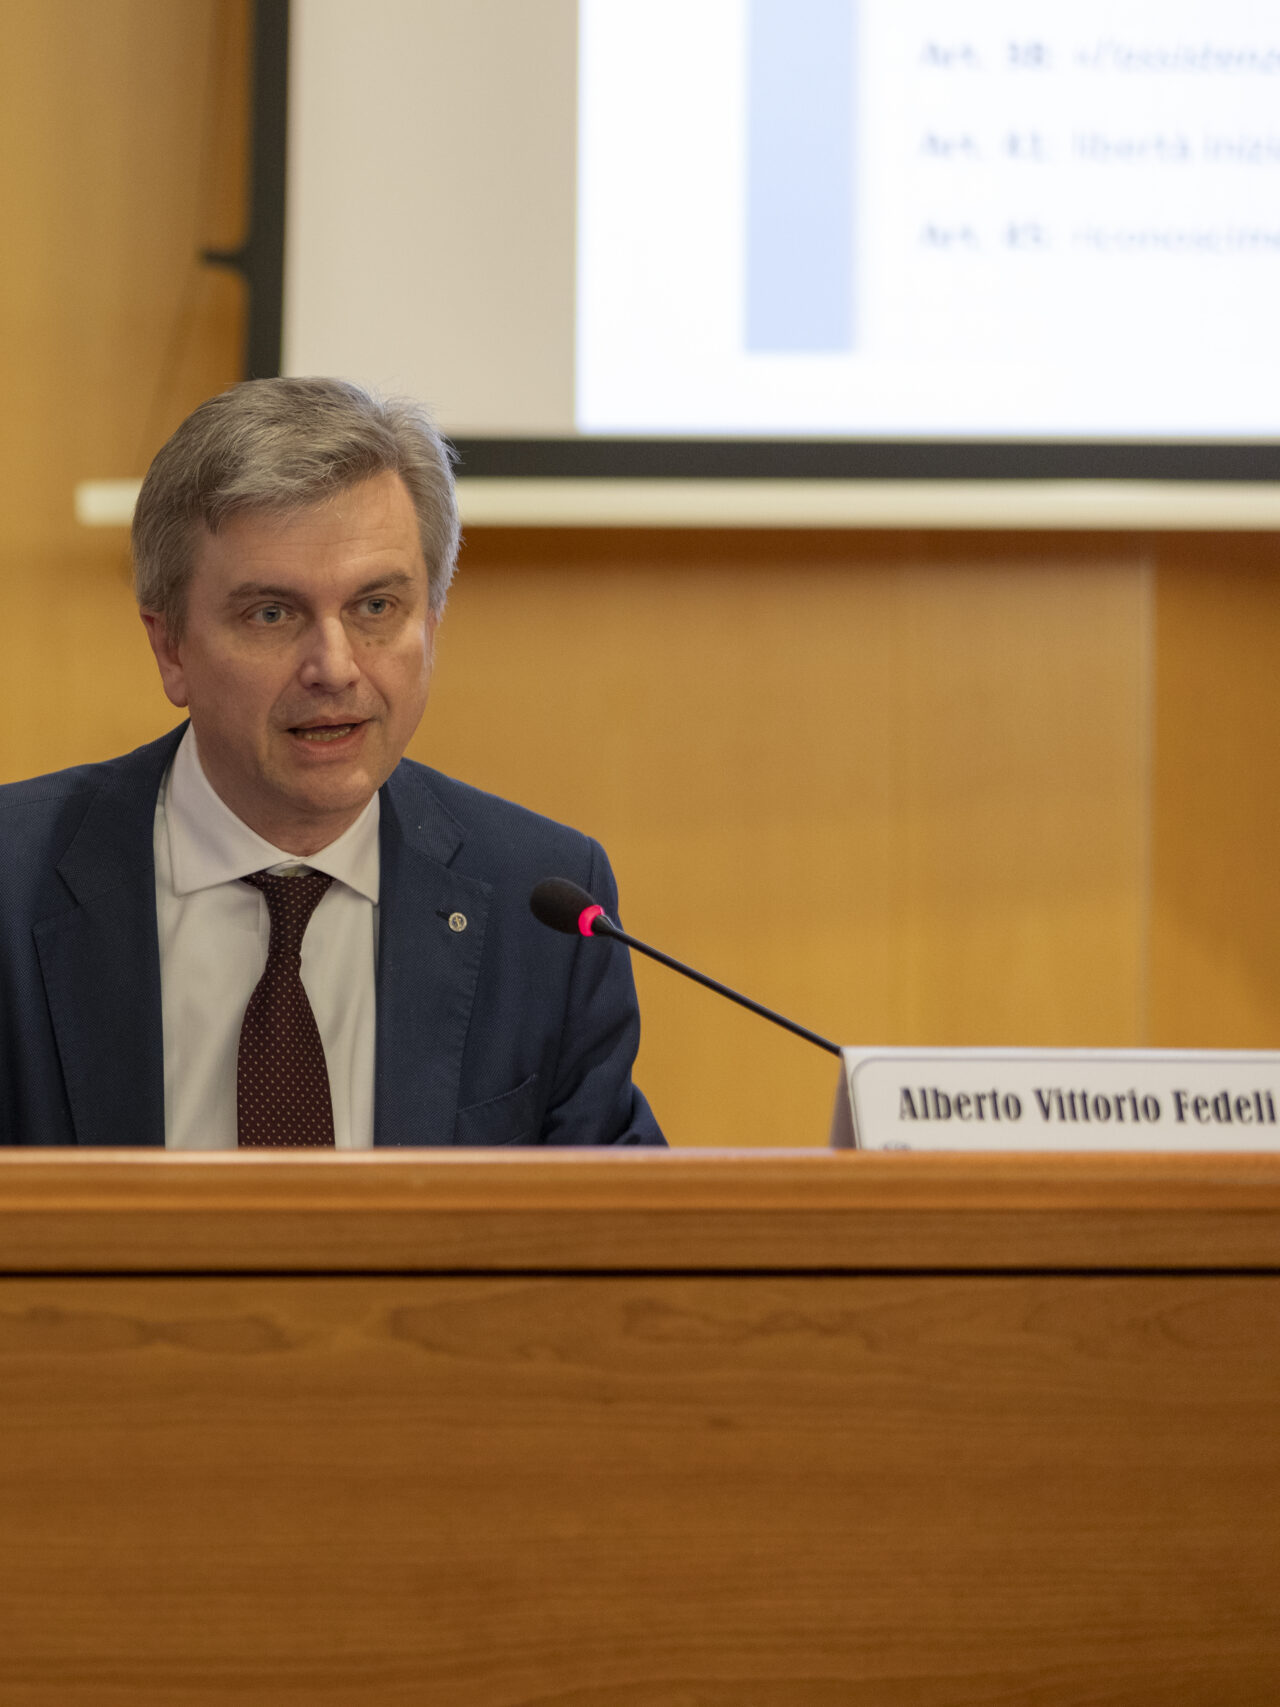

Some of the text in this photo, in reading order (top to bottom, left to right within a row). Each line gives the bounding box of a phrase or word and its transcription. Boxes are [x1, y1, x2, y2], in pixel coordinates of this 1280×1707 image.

[898, 1085, 1277, 1124] Alberto Vittorio Fedeli
